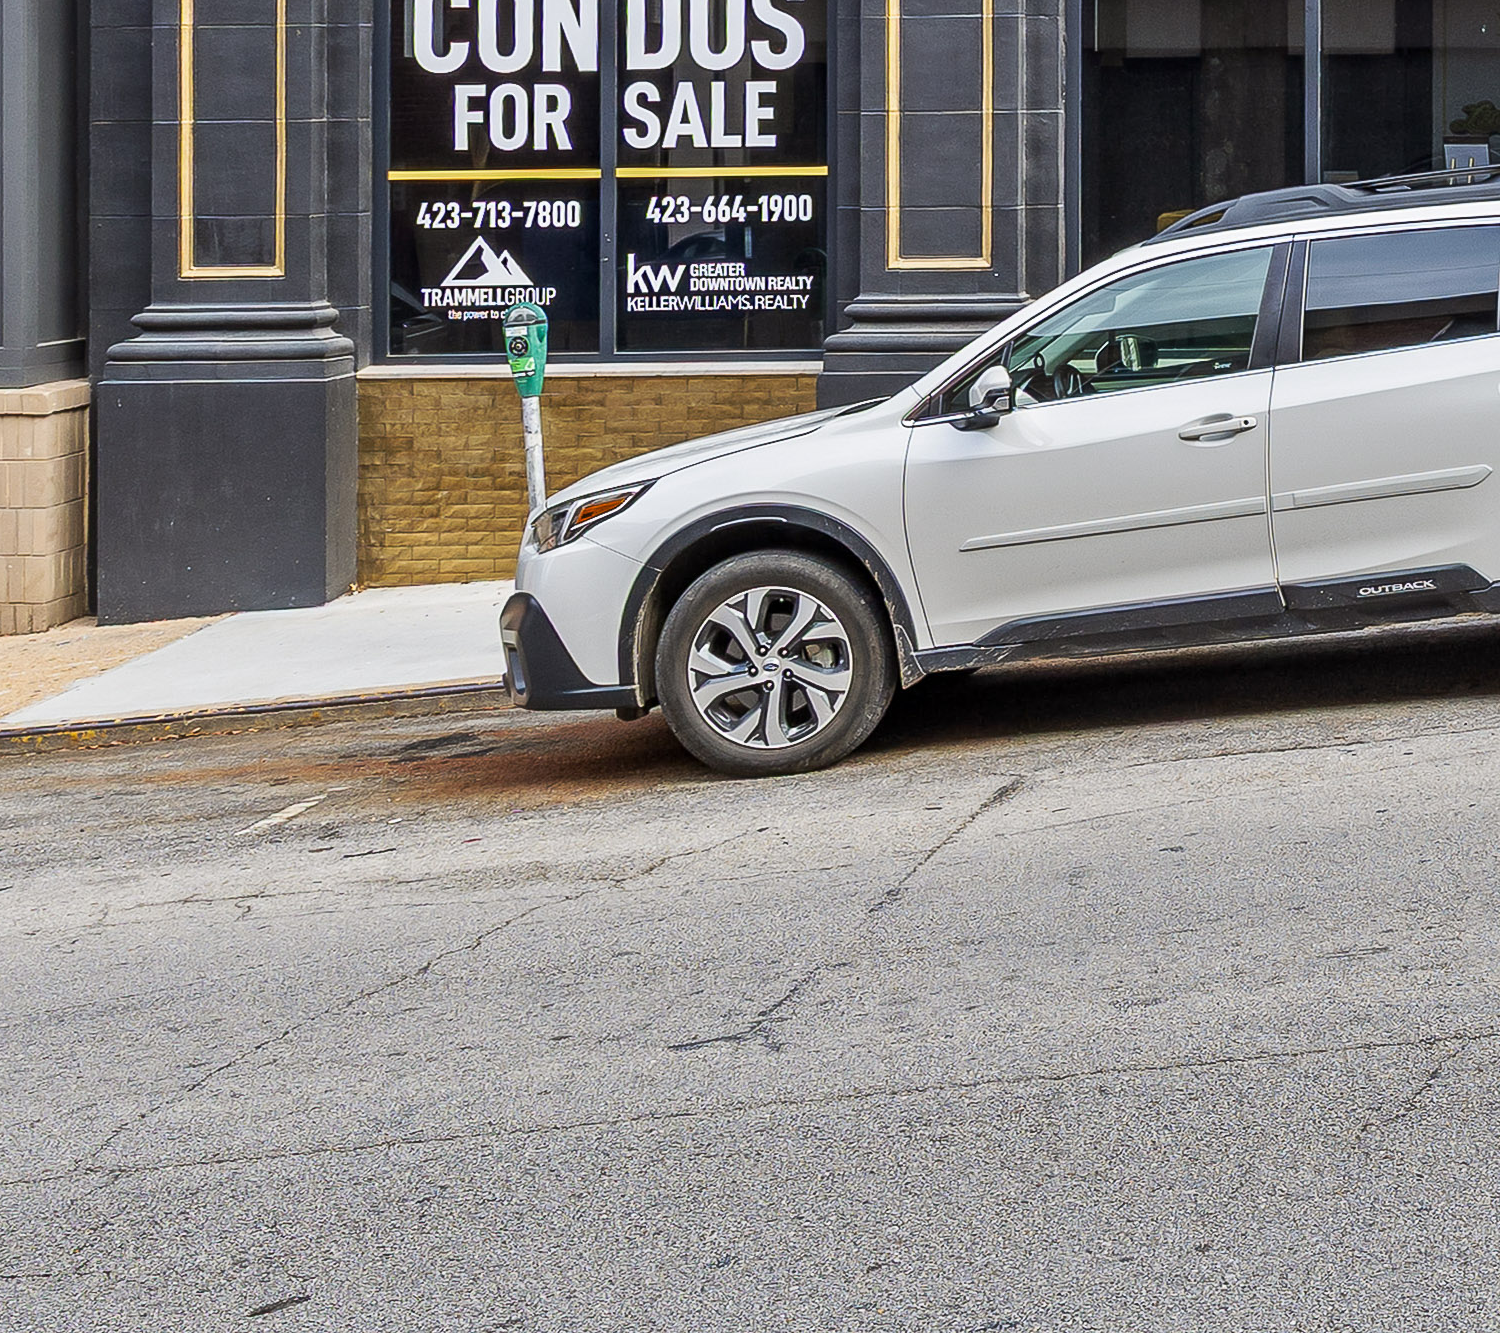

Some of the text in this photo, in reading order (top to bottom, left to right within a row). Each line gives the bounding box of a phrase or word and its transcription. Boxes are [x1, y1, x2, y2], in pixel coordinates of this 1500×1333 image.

[453, 80, 778, 152] FOR SALE
[416, 200, 582, 229] 423-713-7800
[646, 194, 813, 224] 423-664-1900
[689, 262, 745, 277] GREATER
[689, 275, 814, 292] DOWNTOWN REALTY
[447, 309, 463, 320] the
[463, 311, 489, 321] power
[490, 309, 500, 320] to
[1359, 579, 1435, 596] OUTBACK
